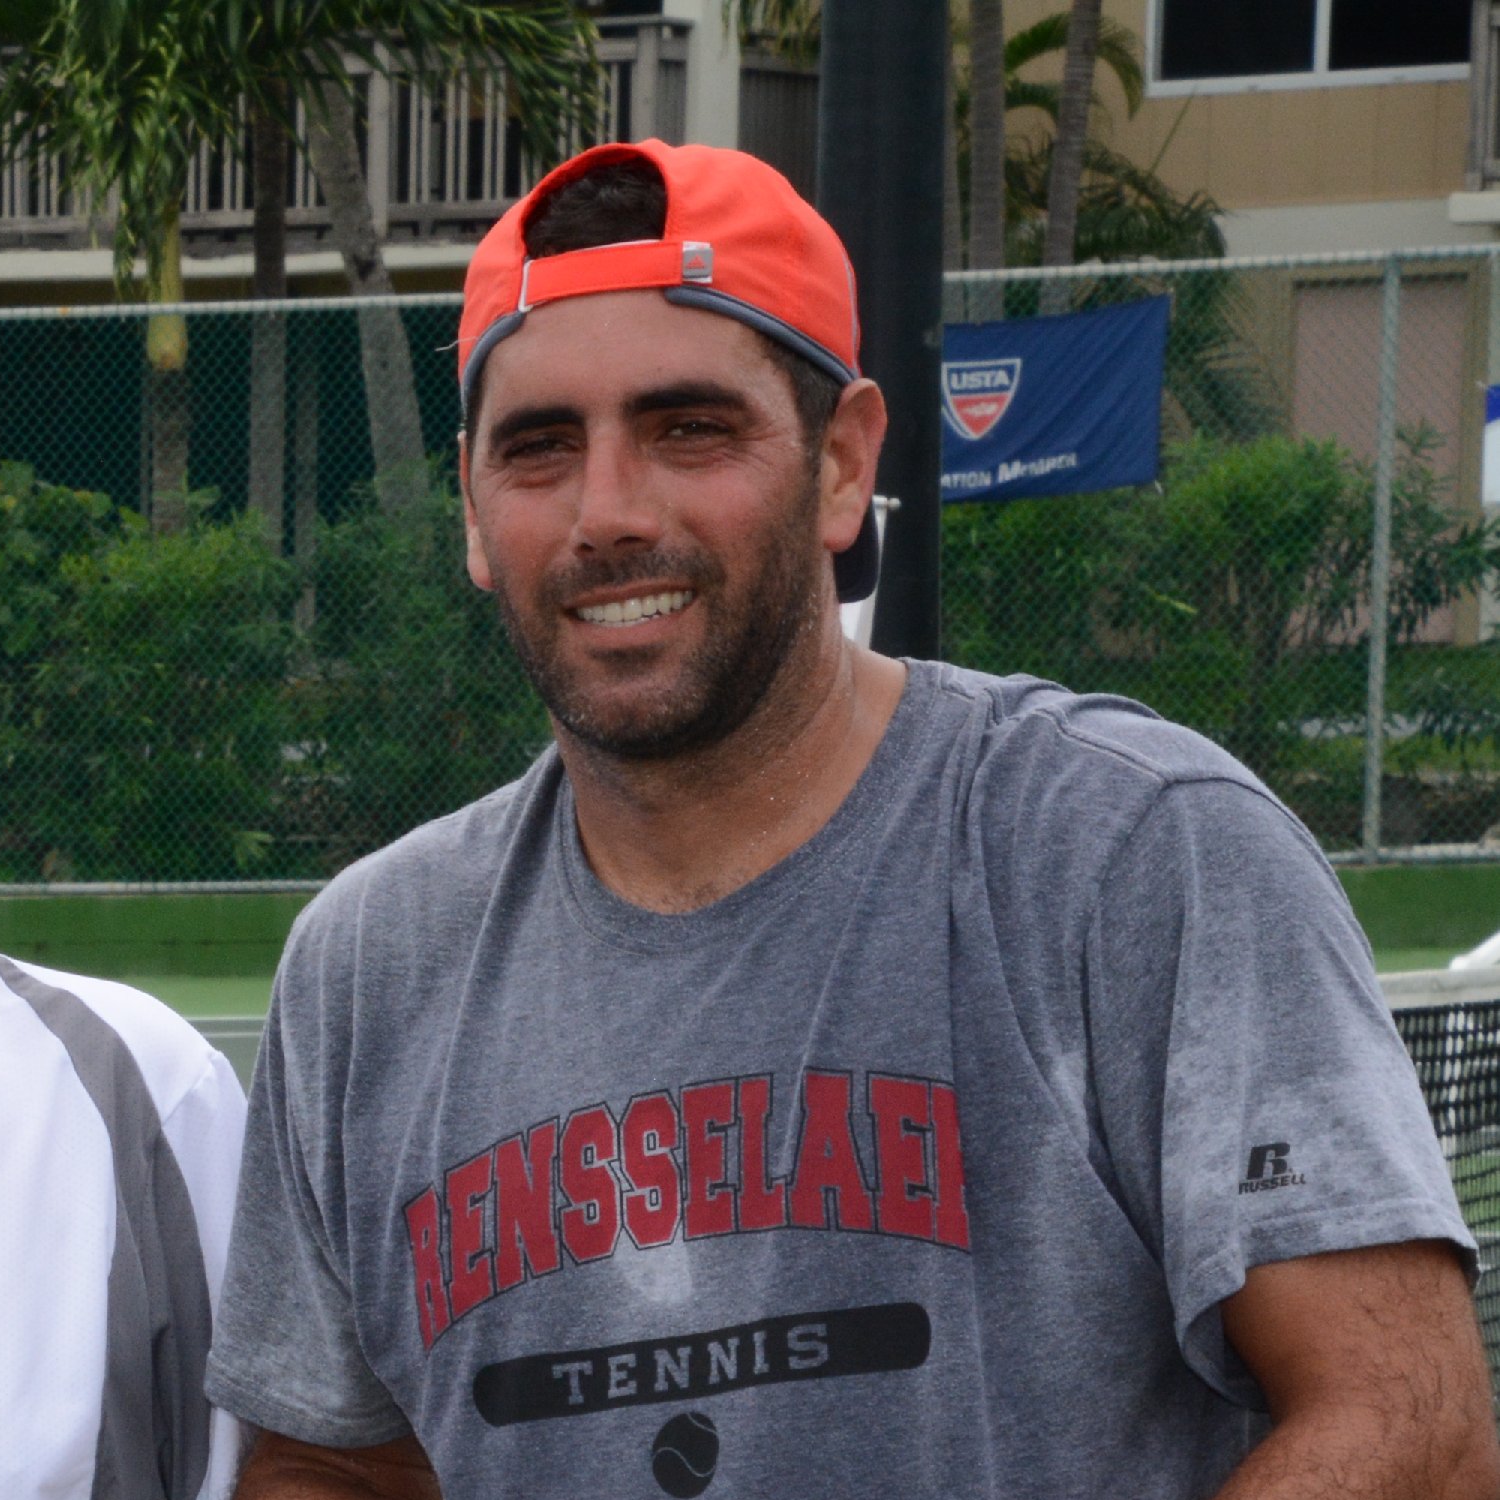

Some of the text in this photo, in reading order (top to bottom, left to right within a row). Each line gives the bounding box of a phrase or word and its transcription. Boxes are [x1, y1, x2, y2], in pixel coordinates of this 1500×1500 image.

[952, 370, 1010, 390] USTA
[1239, 1173, 1307, 1195] RUSSELL
[552, 1322, 830, 1407] TENNIS
